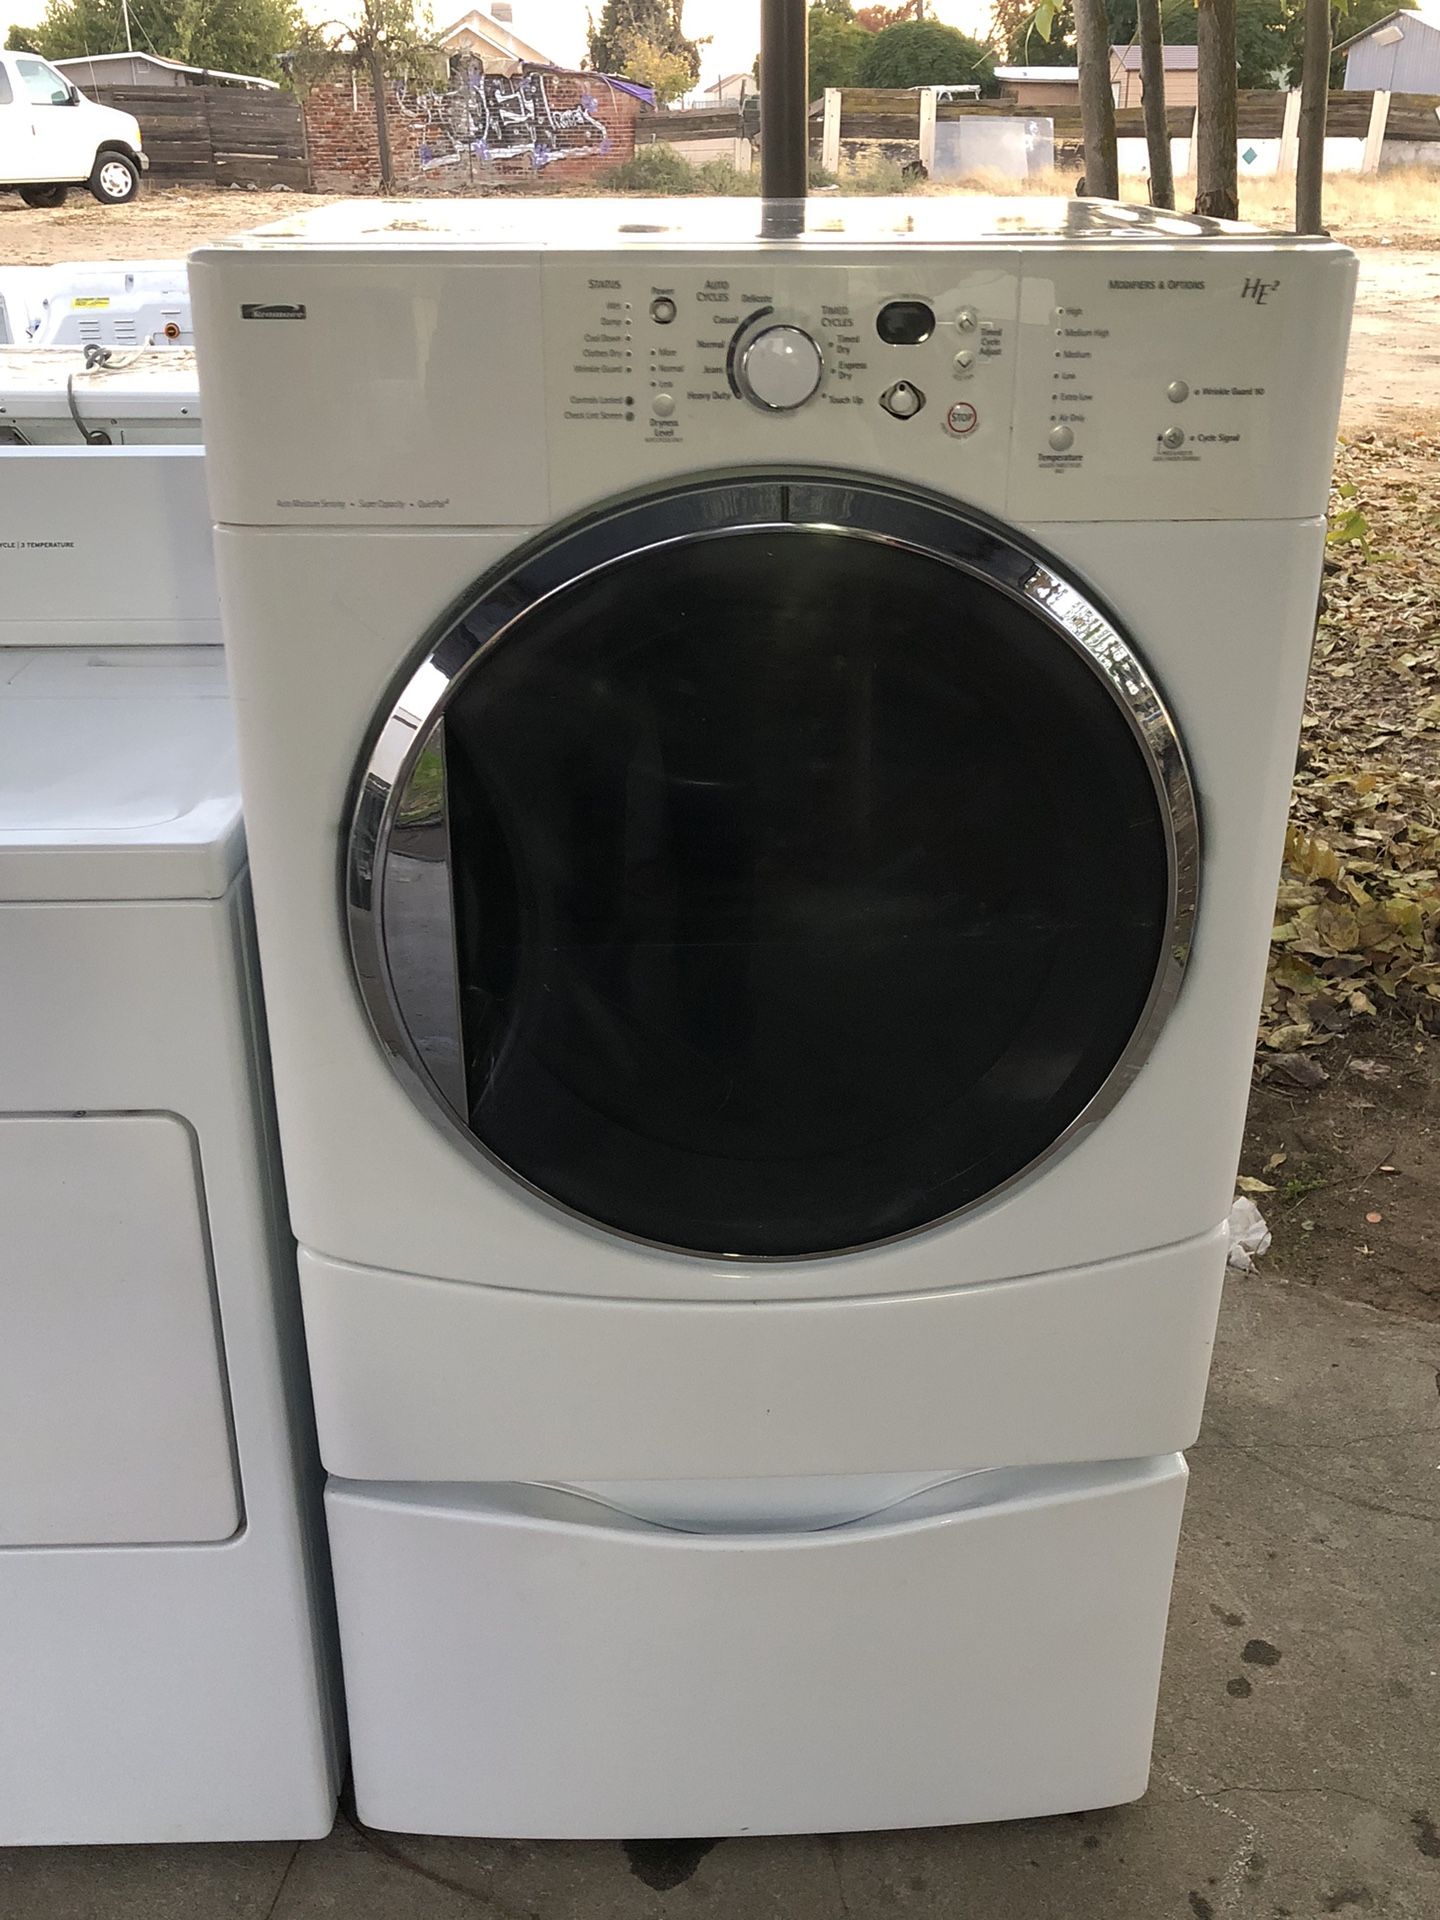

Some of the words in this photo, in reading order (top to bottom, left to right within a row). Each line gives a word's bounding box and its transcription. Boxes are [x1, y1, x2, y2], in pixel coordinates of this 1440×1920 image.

[588, 279, 621, 289] STATUS
[705, 280, 729, 289] AUTO
[1167, 280, 1205, 290] OPTIONS
[696, 291, 729, 302] CYCLES
[821, 317, 854, 327] CYCLES
[951, 412, 974, 422] STOP
[1038, 453, 1084, 463] Temperature
